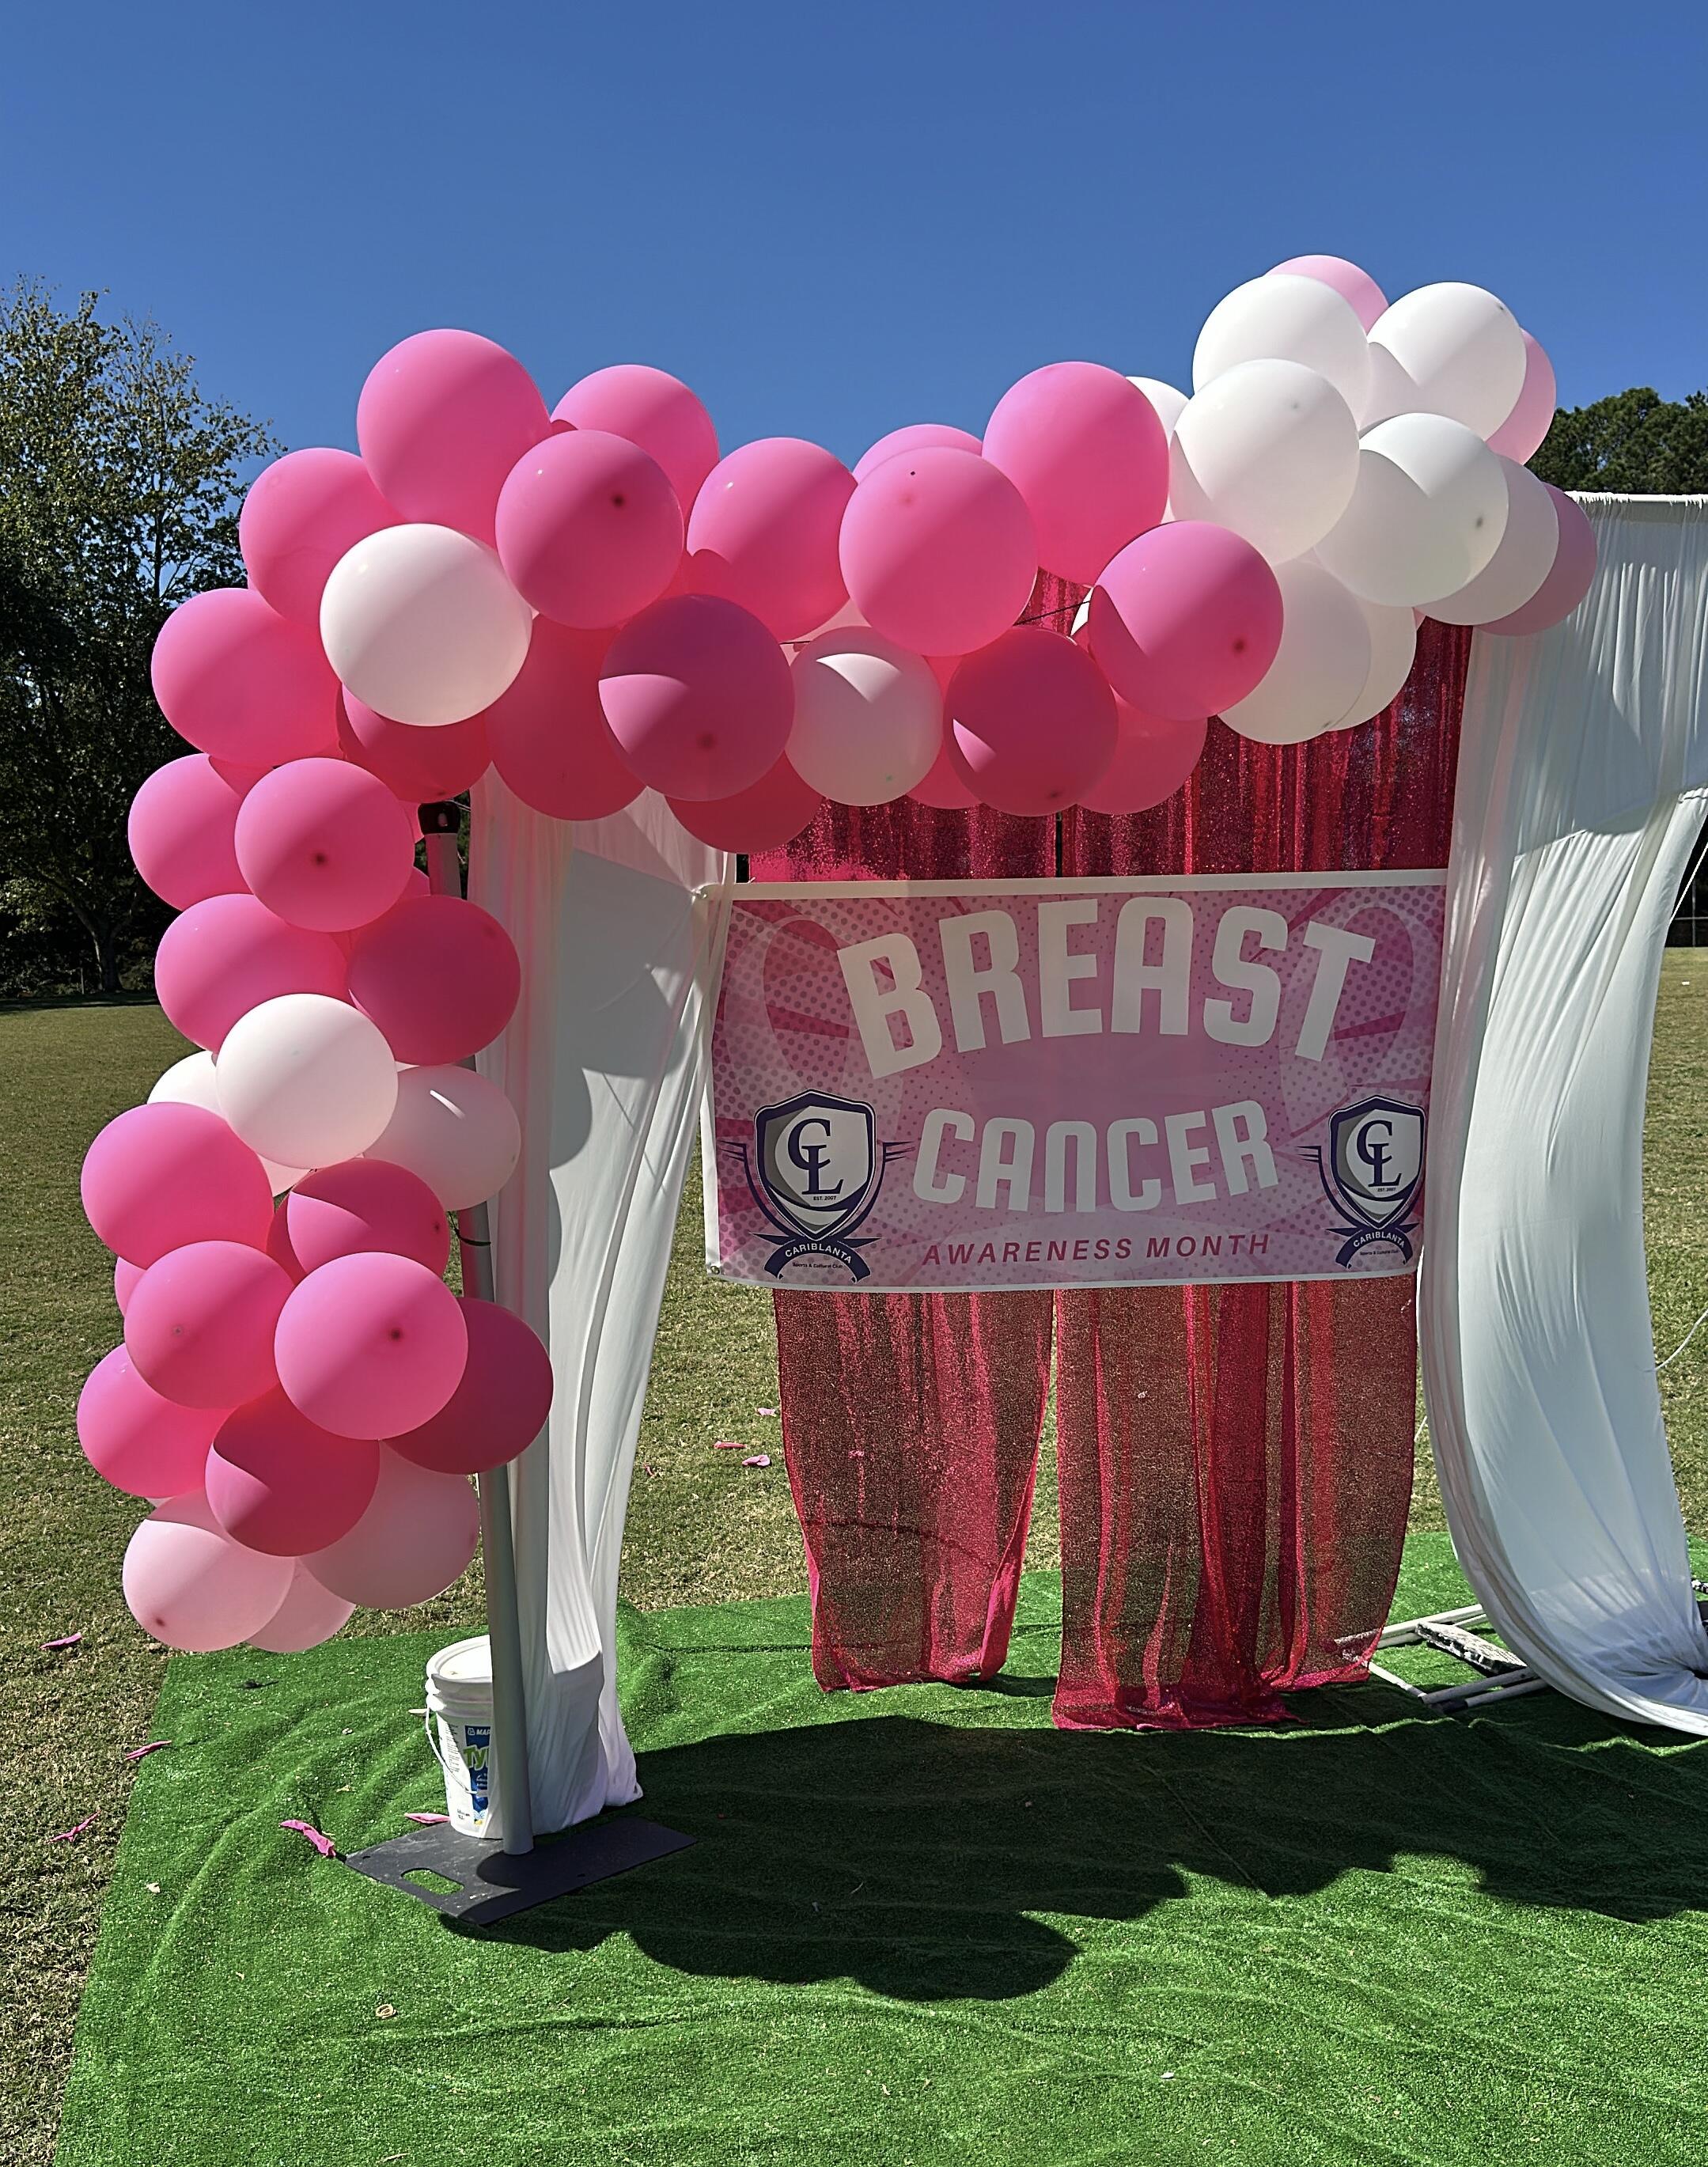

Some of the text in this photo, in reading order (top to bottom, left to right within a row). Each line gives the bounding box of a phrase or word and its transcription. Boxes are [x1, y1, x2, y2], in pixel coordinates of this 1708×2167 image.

[837, 896, 1376, 1079] BREAST
[912, 1100, 1278, 1213] CANCER
[785, 1243, 852, 1263] CARIBLANTA
[922, 1234, 1269, 1265] AWARENESS MONTH
[1353, 1231, 1405, 1248] CARIBLANTA
